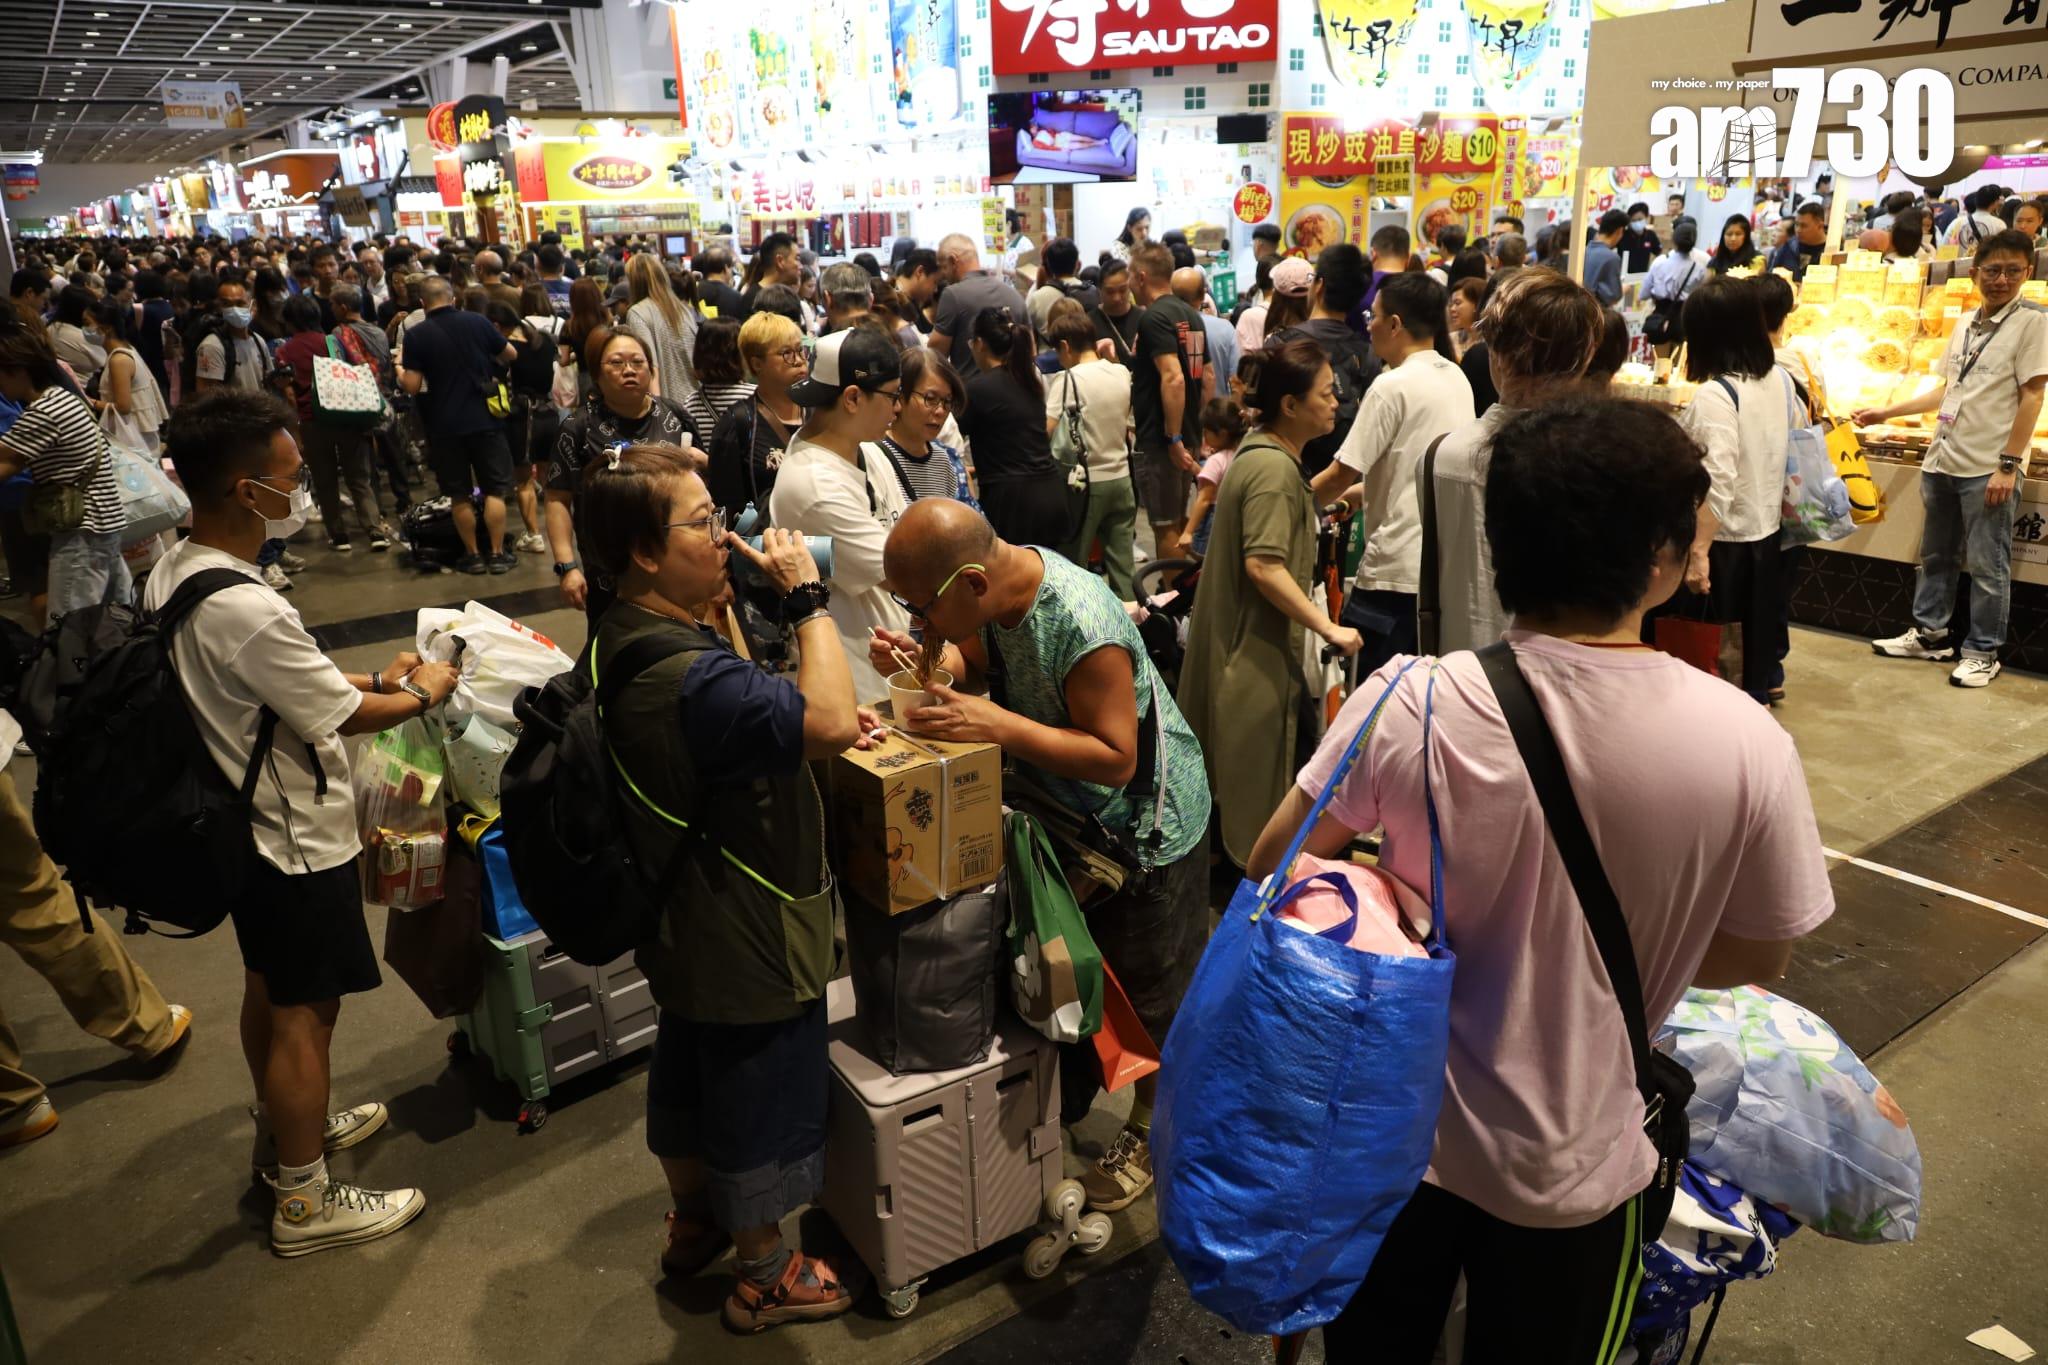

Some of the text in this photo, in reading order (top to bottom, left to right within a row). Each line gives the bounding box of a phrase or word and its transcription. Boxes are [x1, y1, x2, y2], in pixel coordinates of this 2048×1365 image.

[1102, 24, 1270, 56] SAUTAO
[1958, 62, 2048, 87] COMPA
[1470, 134, 1494, 158] $10
[1540, 159, 1561, 177] $20
[1451, 190, 1476, 209] $20
